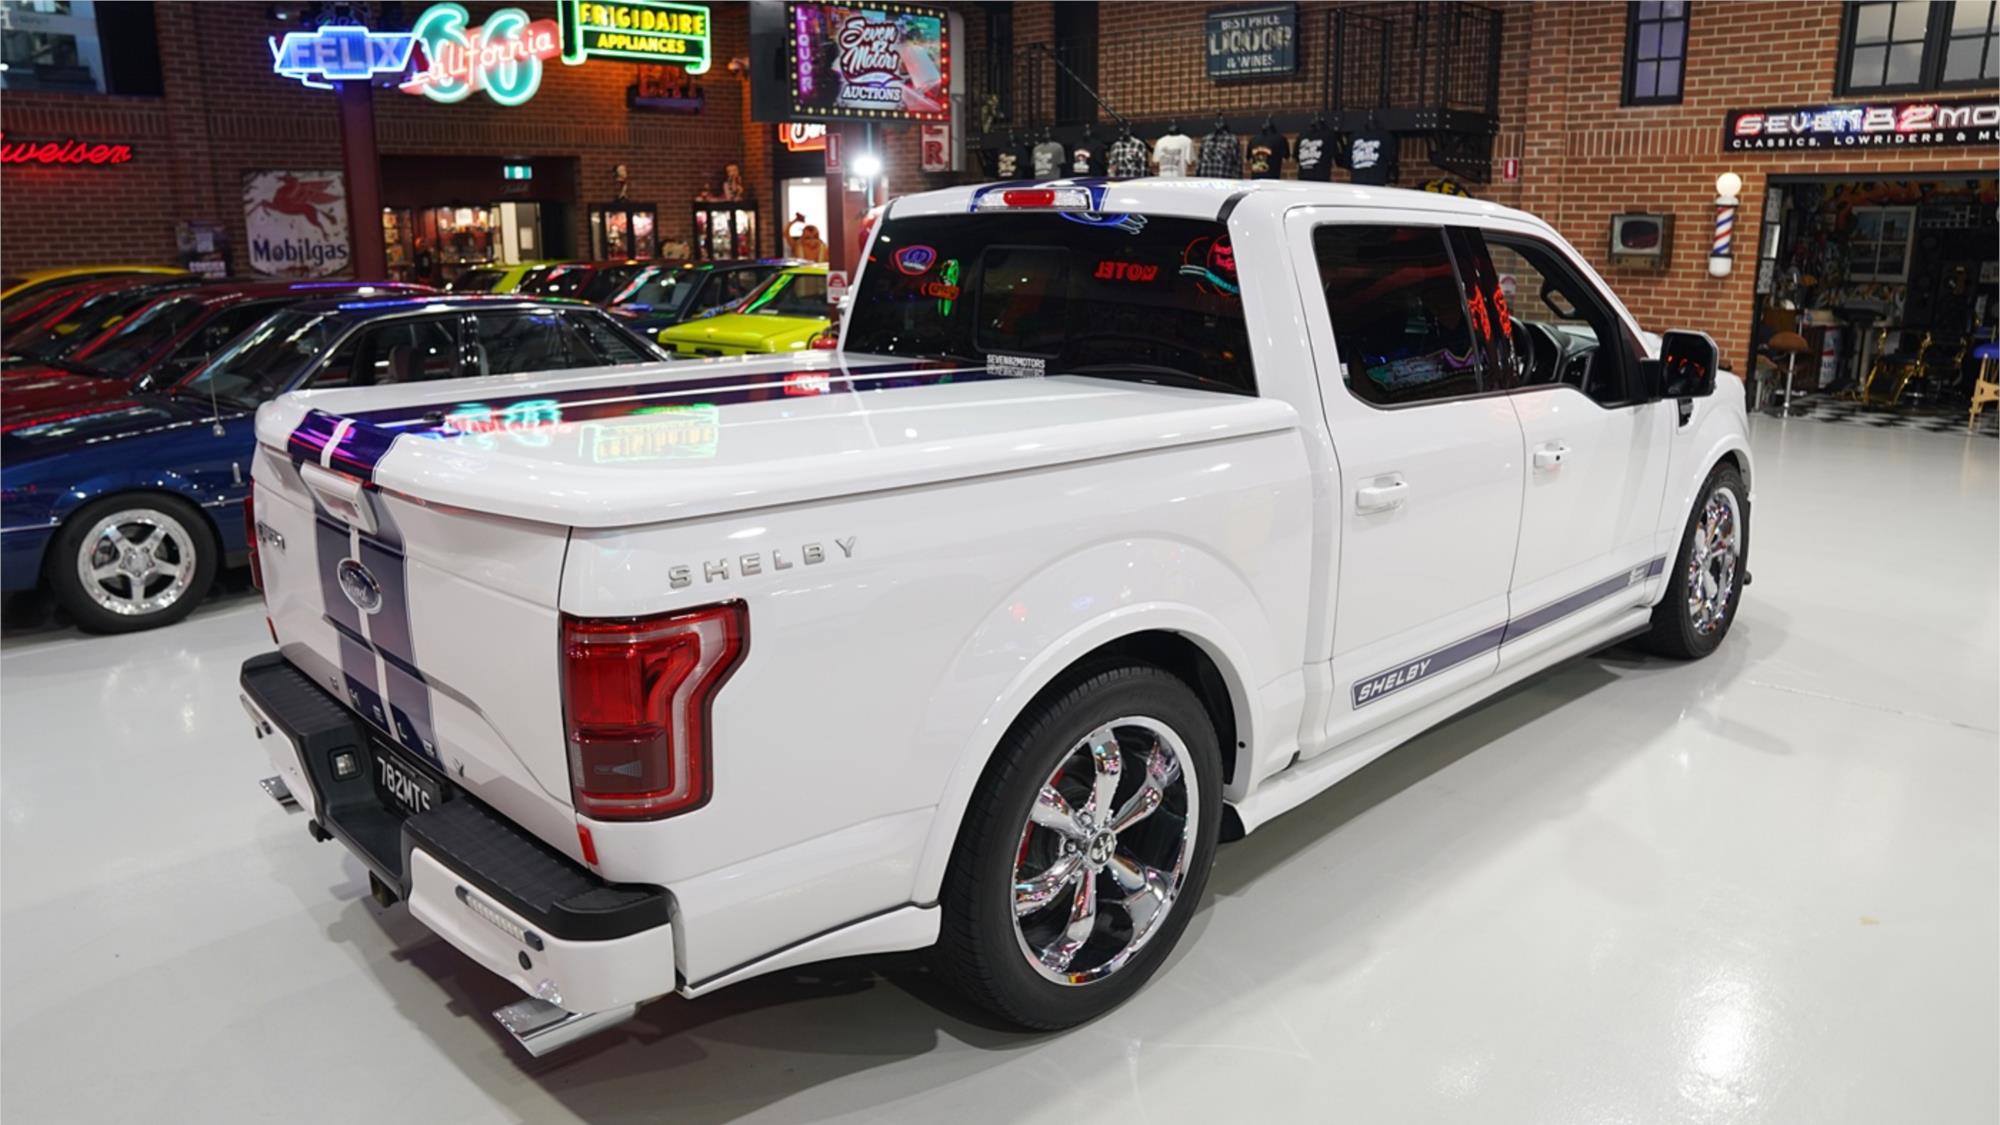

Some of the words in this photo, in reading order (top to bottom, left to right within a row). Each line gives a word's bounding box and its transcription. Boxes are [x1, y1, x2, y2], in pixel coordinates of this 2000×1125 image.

[580, 3, 706, 35] FRIGIDAIRE
[840, 17, 896, 47] Seven
[290, 36, 402, 70] FELIX
[398, 30, 556, 88] alifornia
[597, 33, 687, 54] APPLIANCES
[796, 7, 813, 94] LIQUOR
[842, 45, 898, 74] Motors
[842, 84, 902, 101] AUCTIONS
[0, 131, 133, 164] weiser
[1732, 136, 1821, 149] CLASSICS,
[1833, 132, 1944, 146] LOWRIDERS
[1955, 131, 1967, 142] &
[252, 238, 348, 266] Mobilgas
[668, 535, 857, 590] SHELBY
[1357, 658, 1432, 702] SHELBY
